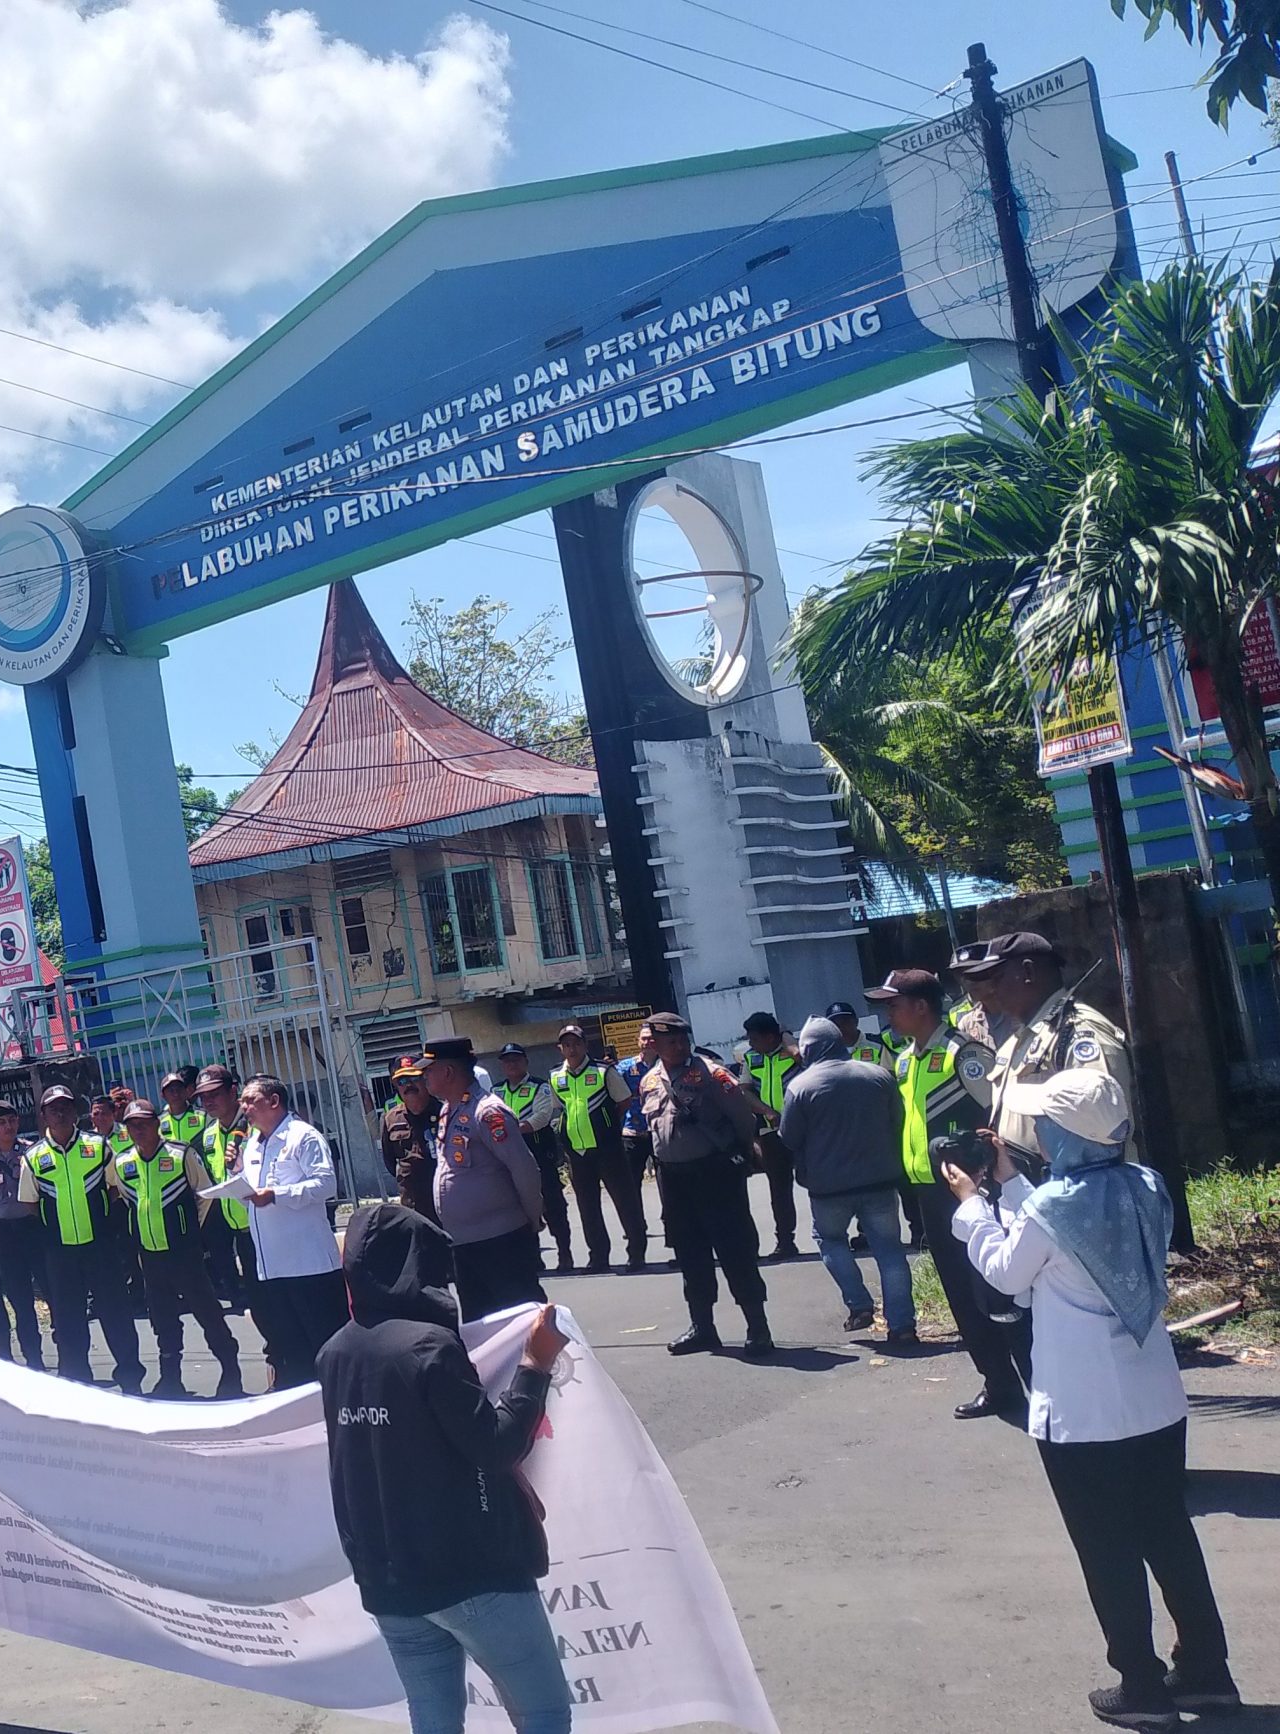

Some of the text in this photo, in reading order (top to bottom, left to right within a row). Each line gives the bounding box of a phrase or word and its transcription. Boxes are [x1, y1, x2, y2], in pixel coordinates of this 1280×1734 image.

[210, 285, 752, 514] KEMENTERIAN KELAUTAN DAN PERIKANAN
[323, 443, 506, 536] PERIKANAN
[517, 366, 717, 463] SAMUDERA
[730, 304, 882, 385] BITUNG
[344, 427, 469, 487] JENDERAL
[478, 358, 636, 435] PERIKANAN
[648, 298, 792, 368] TANGKAP
[5, 651, 53, 671] KELAUTAN
[52, 634, 70, 656] DAN
